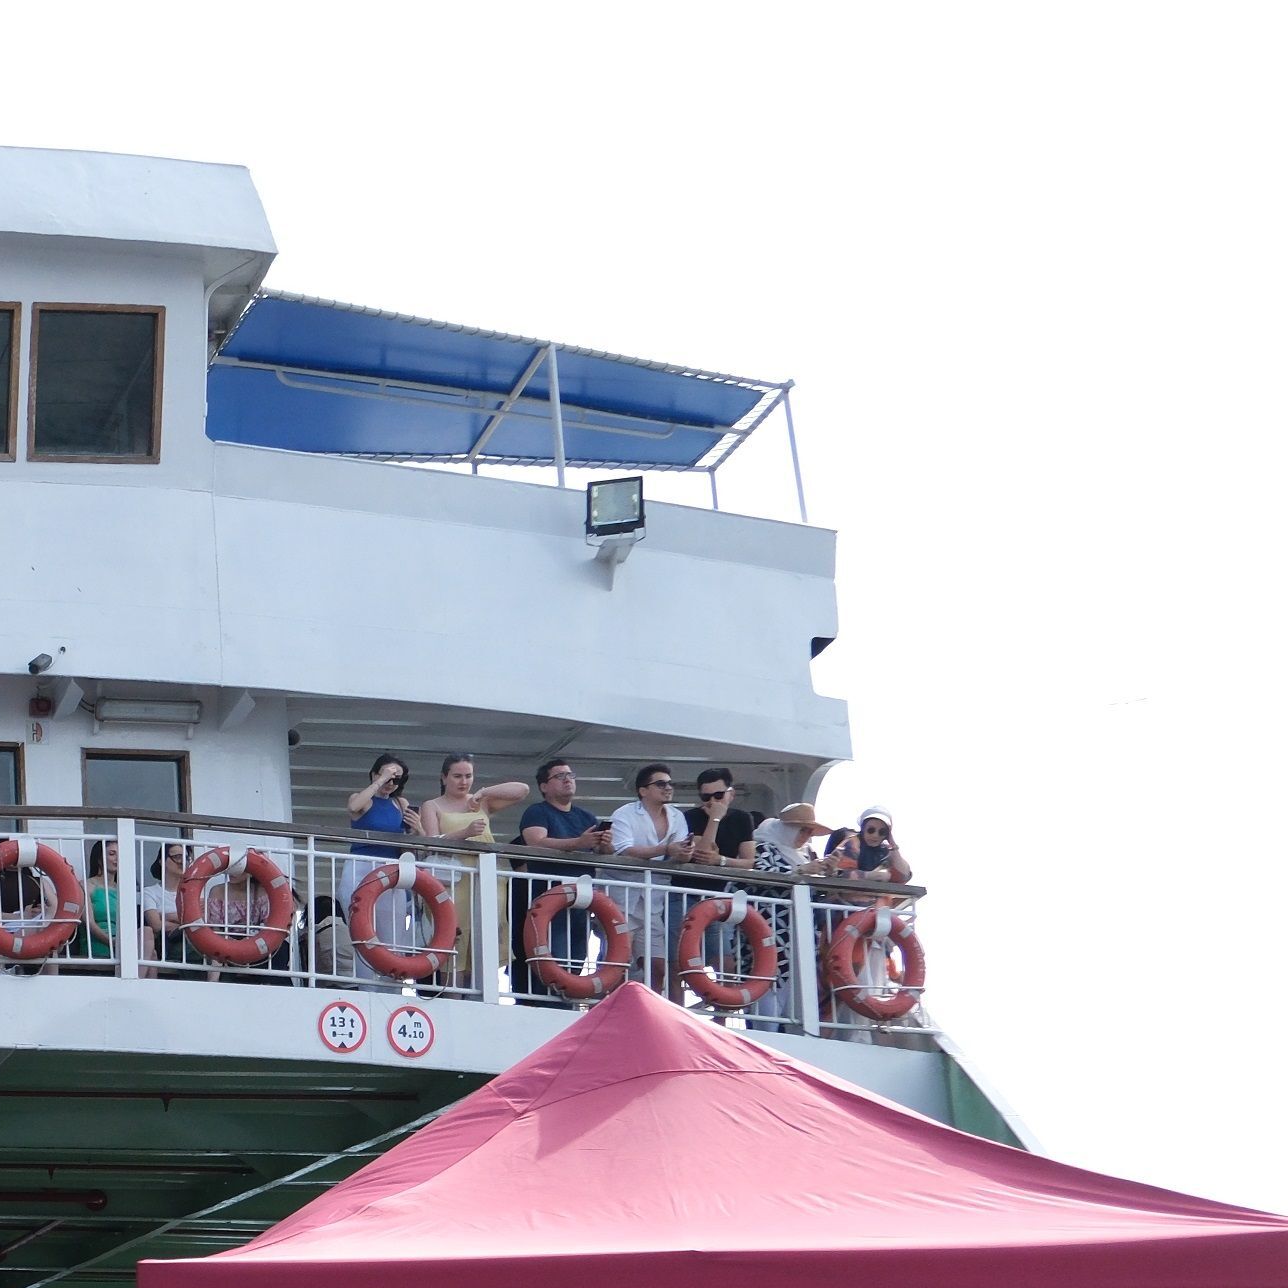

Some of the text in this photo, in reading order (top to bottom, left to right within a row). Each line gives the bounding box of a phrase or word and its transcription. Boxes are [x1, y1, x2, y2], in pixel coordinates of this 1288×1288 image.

[329, 1016, 355, 1028] 13 t
[397, 1024, 425, 1039] 4.10
